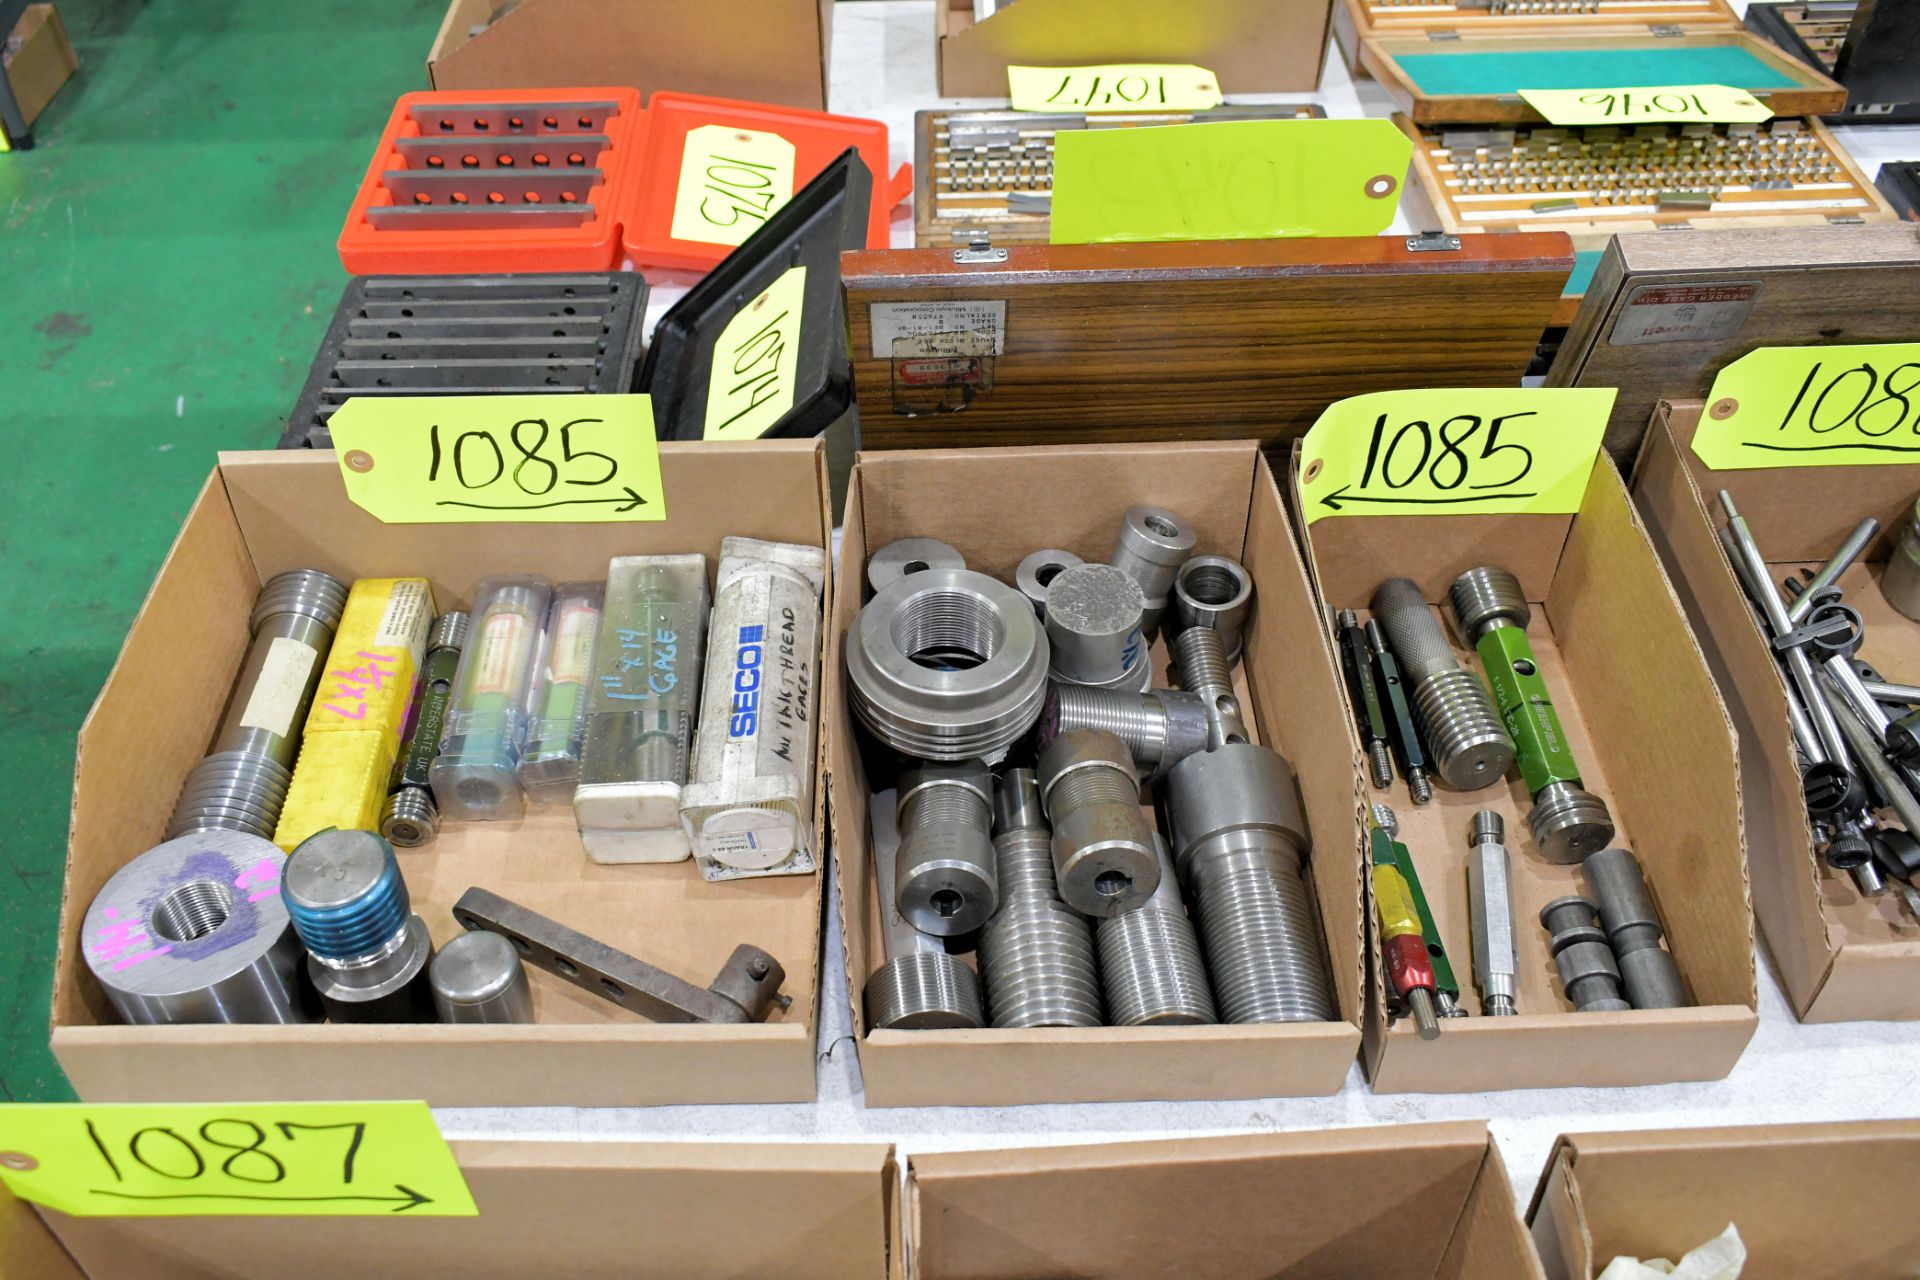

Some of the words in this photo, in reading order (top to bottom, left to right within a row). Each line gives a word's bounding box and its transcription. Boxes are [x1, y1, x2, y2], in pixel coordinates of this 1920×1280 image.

[1046, 76, 1166, 107] 1047
[1580, 93, 1708, 117] 1046
[700, 154, 777, 227] 1075
[719, 309, 790, 431] 1074
[1779, 362, 1920, 437] 108
[429, 418, 619, 496] 1085
[1360, 410, 1538, 490] 1085
[648, 627, 679, 694] GAGE
[776, 607, 795, 687] THREAD
[420, 690, 443, 758] INTERSTATE
[730, 645, 763, 738] SECO
[415, 756, 429, 771] UK
[86, 1118, 366, 1185] 1087
